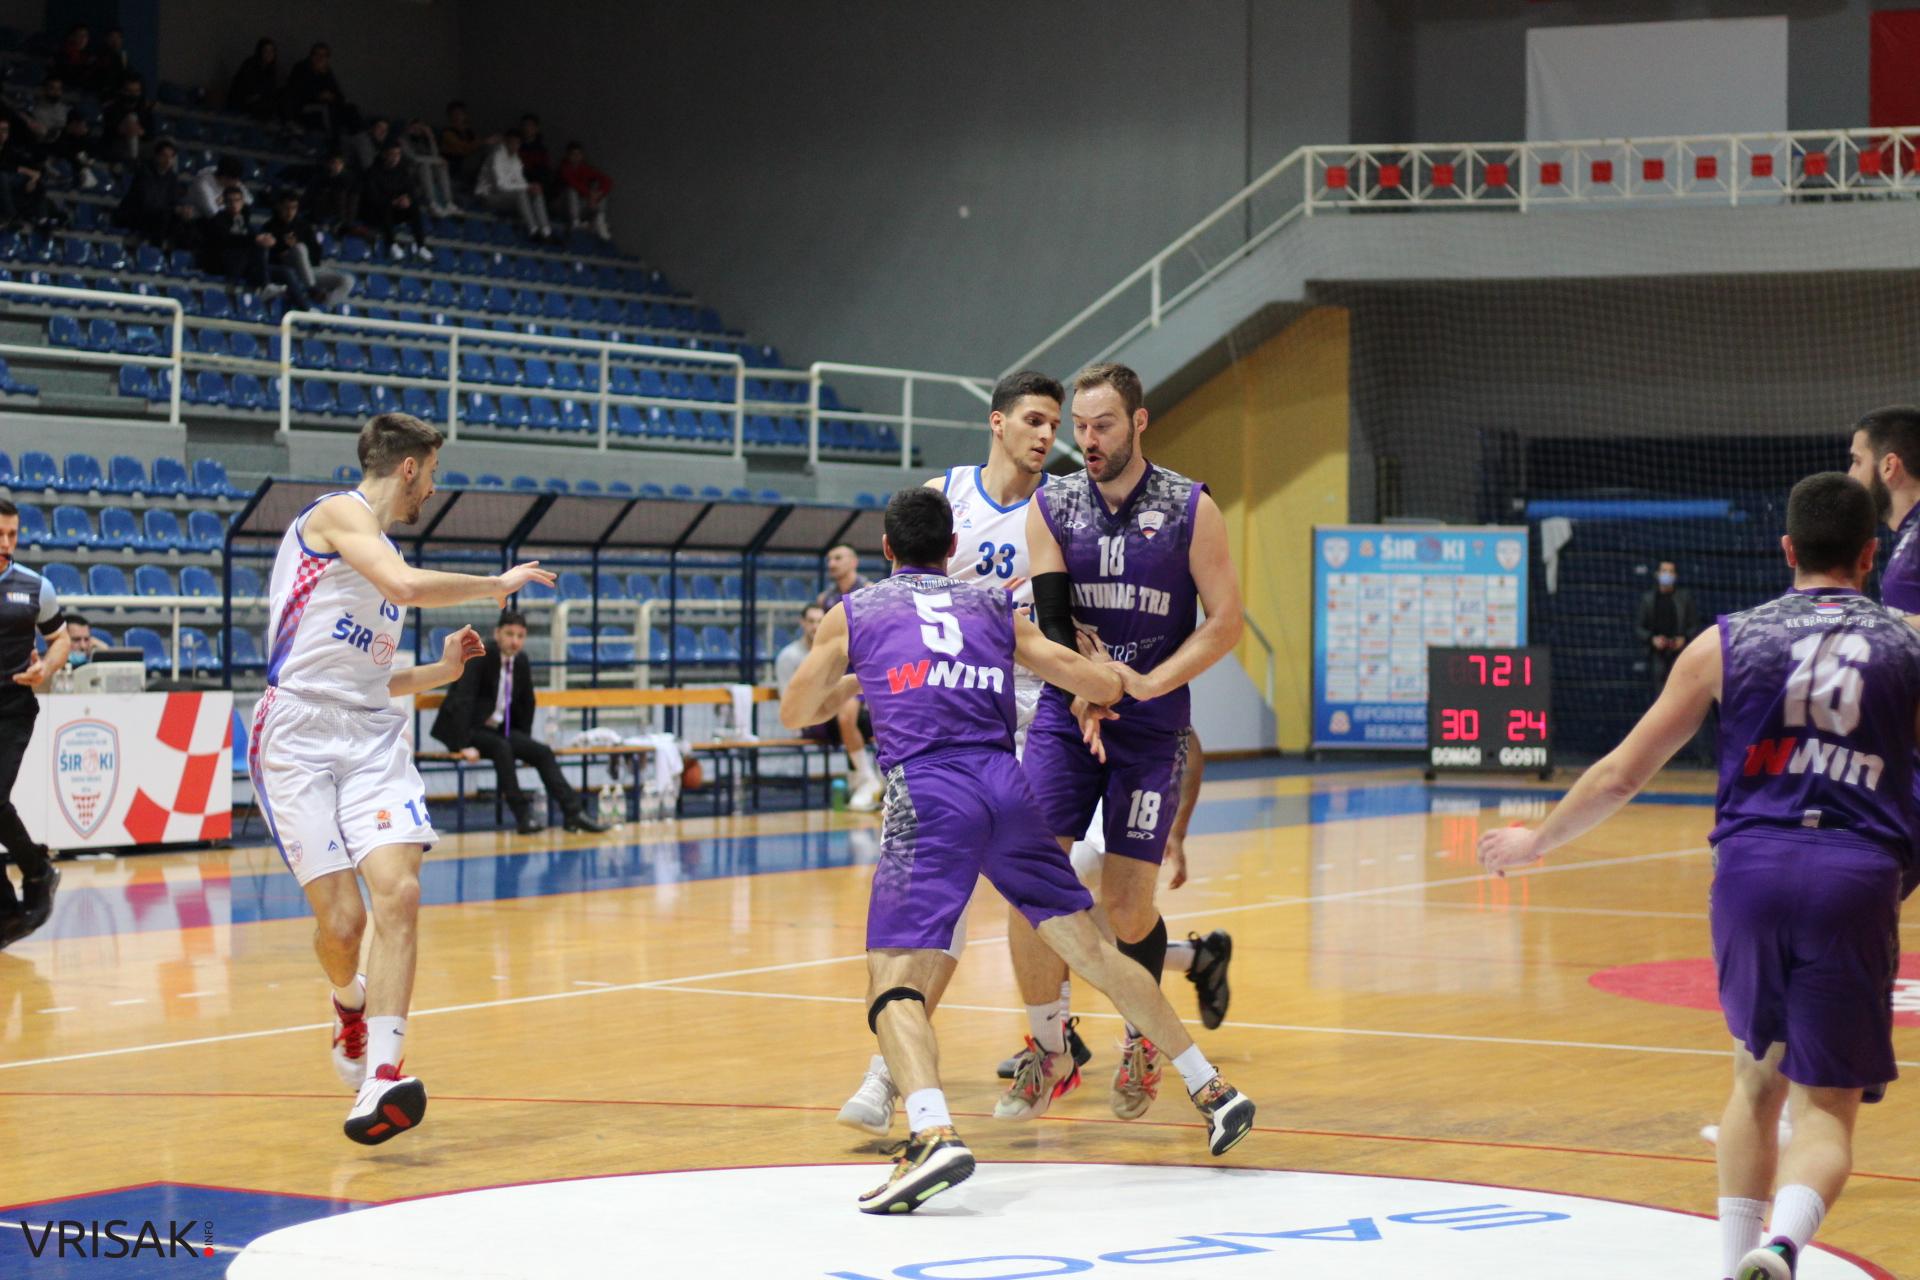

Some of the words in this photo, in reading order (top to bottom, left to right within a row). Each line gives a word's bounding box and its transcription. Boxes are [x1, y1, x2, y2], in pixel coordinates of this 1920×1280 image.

[976, 541, 1016, 579] 33
[1098, 536, 1125, 577] 18
[1071, 582, 1136, 610] ATUNAC
[1139, 585, 1171, 616] TRB
[912, 591, 964, 657] 5
[1784, 632, 1872, 737] 16
[1441, 709, 1479, 740] 30
[1507, 709, 1547, 741] 24
[1498, 746, 1547, 766] GOSTI
[1127, 789, 1162, 831] 18
[824, 1203, 1572, 1280] SAPO
